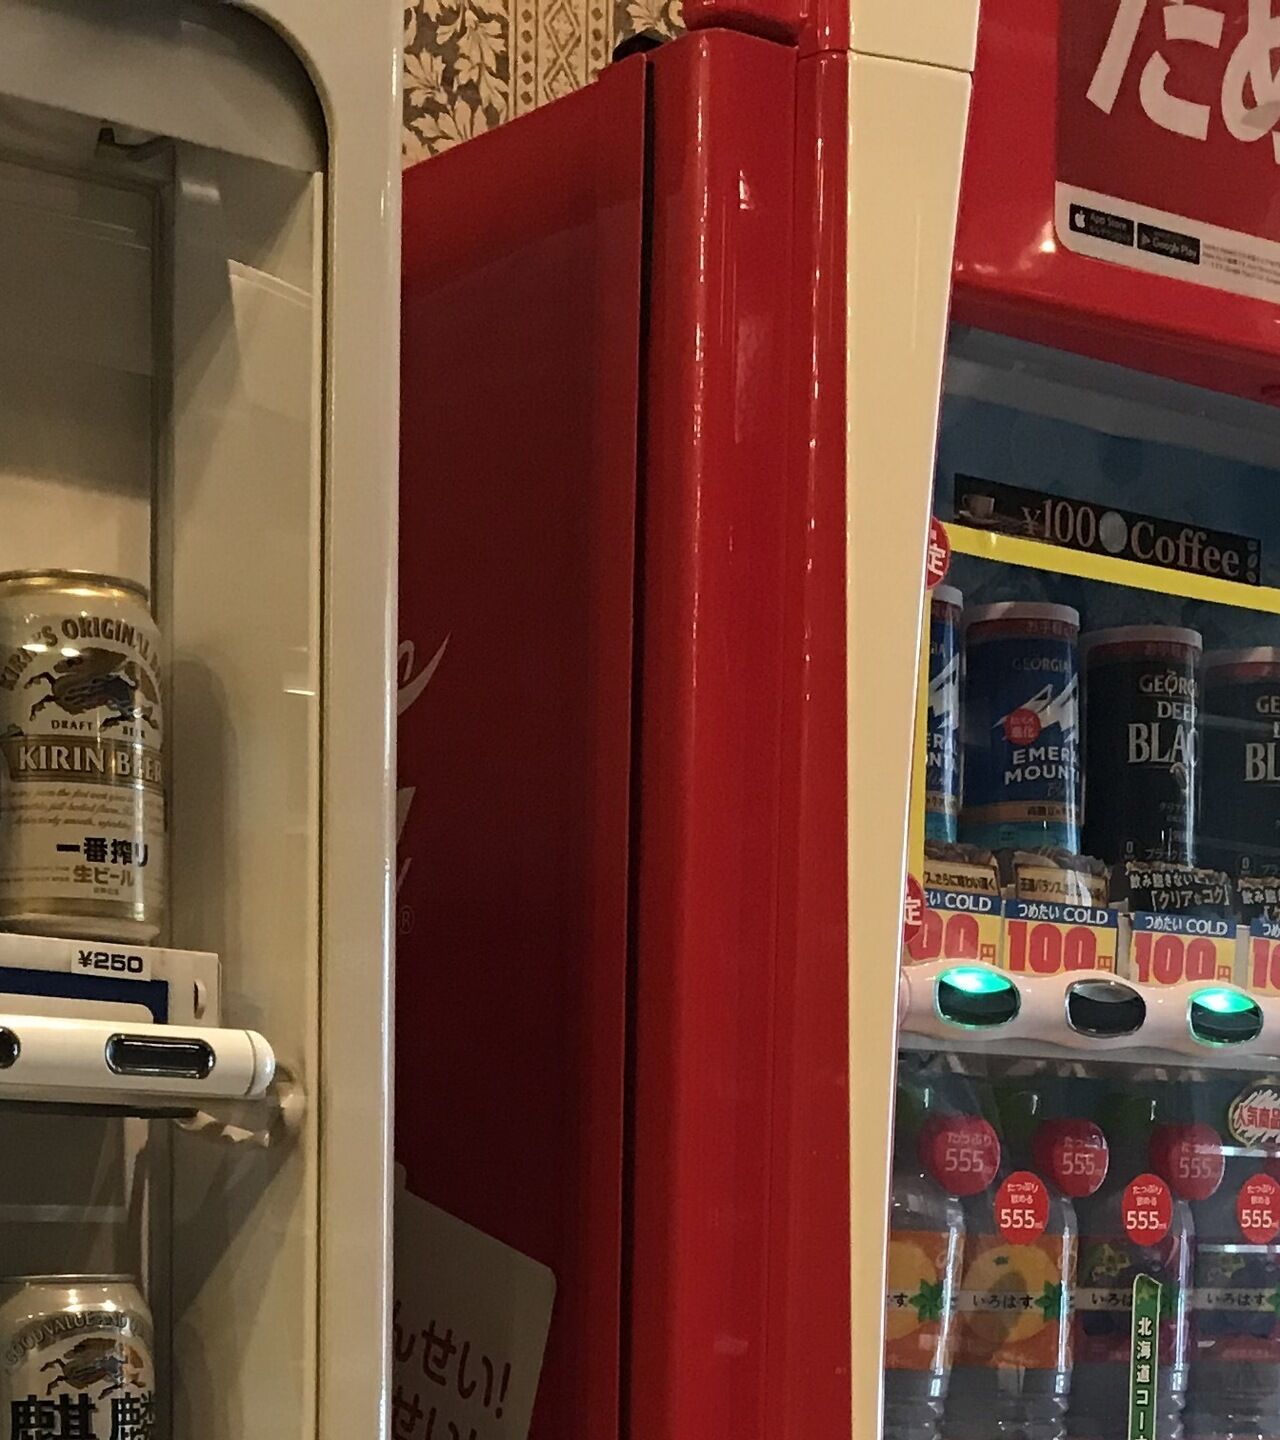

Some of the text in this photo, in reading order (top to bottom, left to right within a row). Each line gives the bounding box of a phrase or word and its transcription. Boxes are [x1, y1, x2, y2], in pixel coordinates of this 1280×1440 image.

[1132, 519, 1240, 579] Coffee
[51, 719, 92, 731] DRAFT
[20, 745, 105, 774] KIRIN
[56, 837, 149, 866] 一番搾り
[72, 864, 134, 887] 生ビール
[945, 894, 991, 912] COLD
[1018, 904, 1108, 924] つめたい COLD
[1145, 916, 1228, 936] つめたい COLD
[78, 950, 143, 974] ¥250
[972, 1292, 1034, 1310] いろはす
[1206, 1292, 1265, 1306] いろはす
[44, 1314, 91, 1337] VALUE
